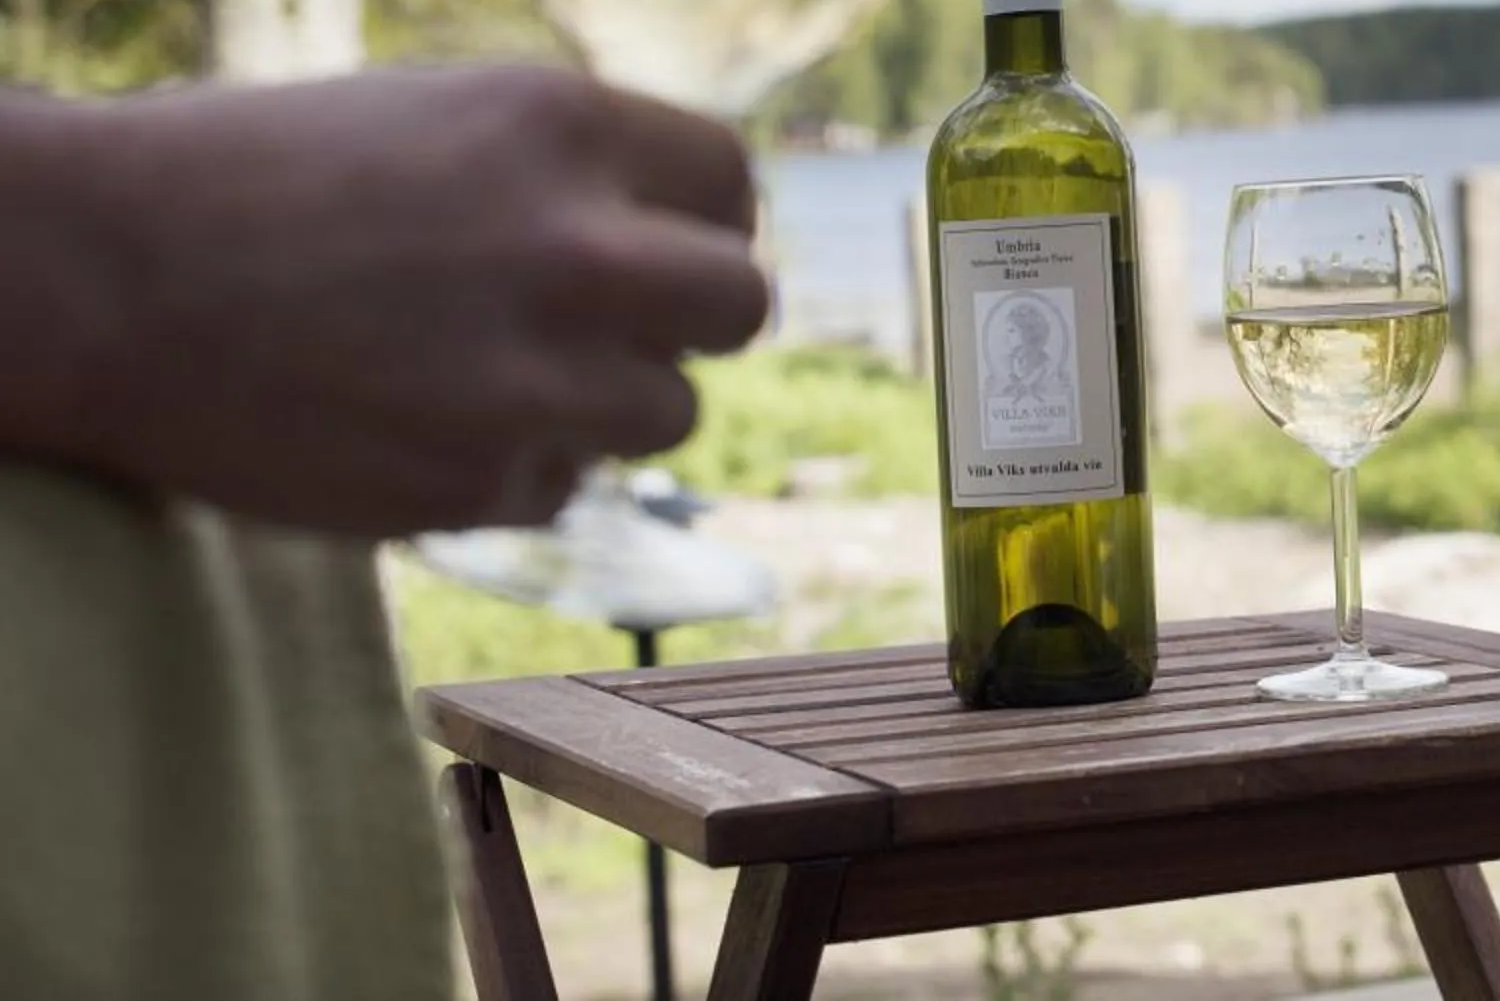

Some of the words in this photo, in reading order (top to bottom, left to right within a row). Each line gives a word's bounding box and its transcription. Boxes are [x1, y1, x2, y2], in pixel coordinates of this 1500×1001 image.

[995, 238, 1041, 255] Umbria
[991, 407, 1030, 421] VILLA
[966, 463, 993, 478] Villa
[997, 462, 1025, 477] Viks
[1029, 459, 1079, 477] utvalda
